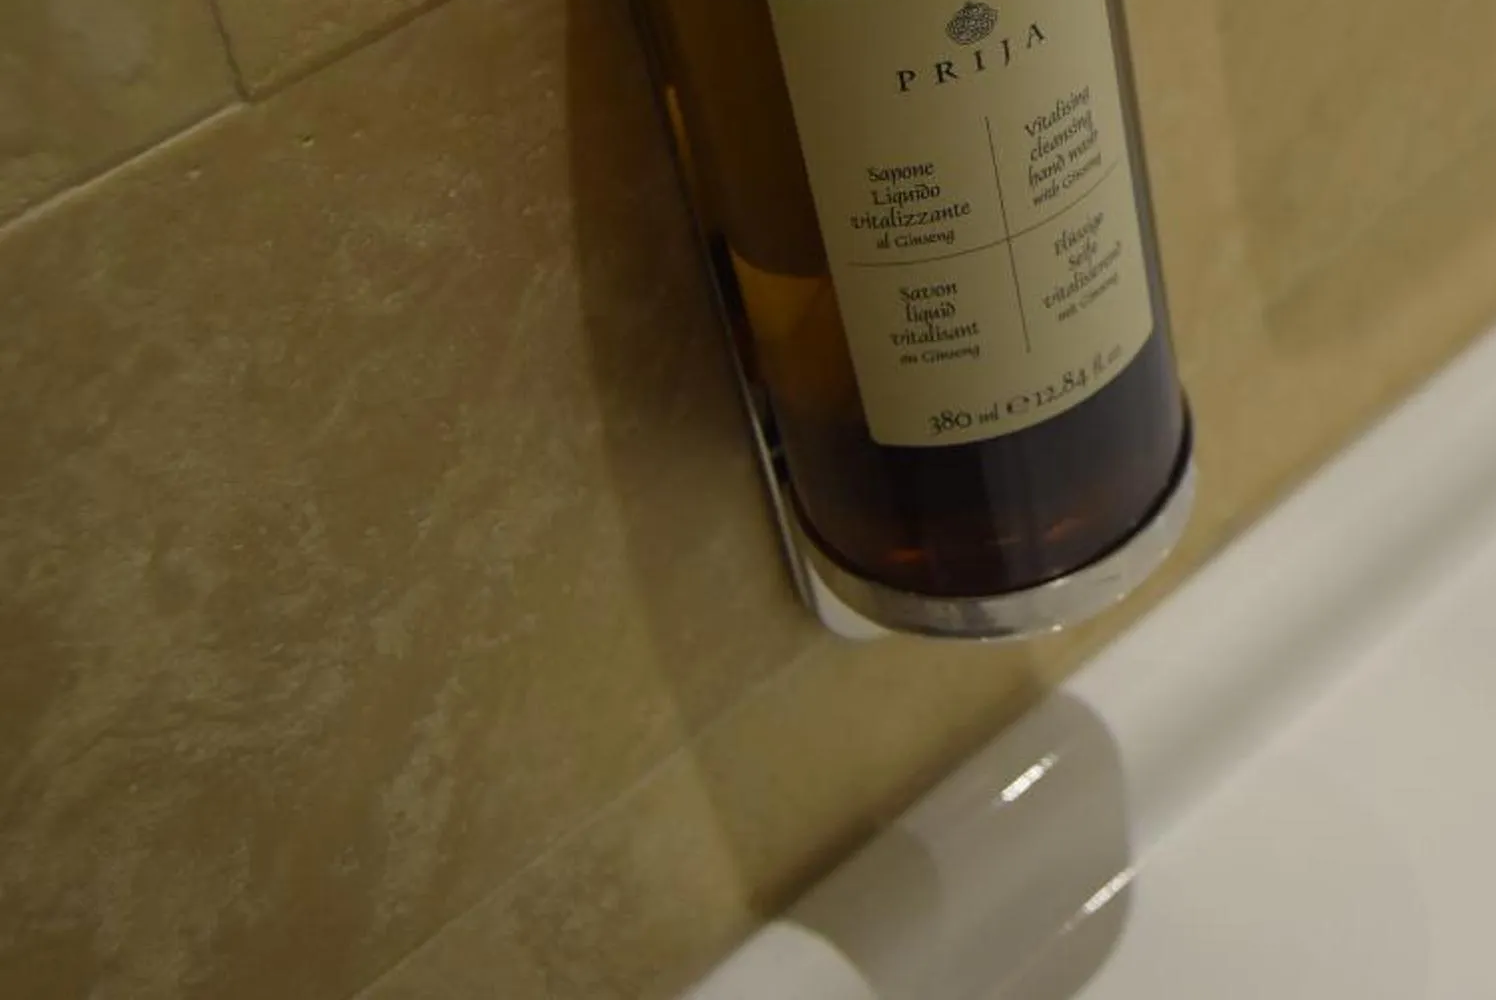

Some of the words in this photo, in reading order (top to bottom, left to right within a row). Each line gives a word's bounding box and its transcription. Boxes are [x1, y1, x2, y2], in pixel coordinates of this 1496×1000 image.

[896, 21, 1046, 92] PRIJA
[867, 161, 935, 185] Sapone
[871, 183, 941, 208] Liquido
[894, 228, 956, 249] Ginseng
[928, 409, 973, 437] 380
[979, 403, 999, 425] ml
